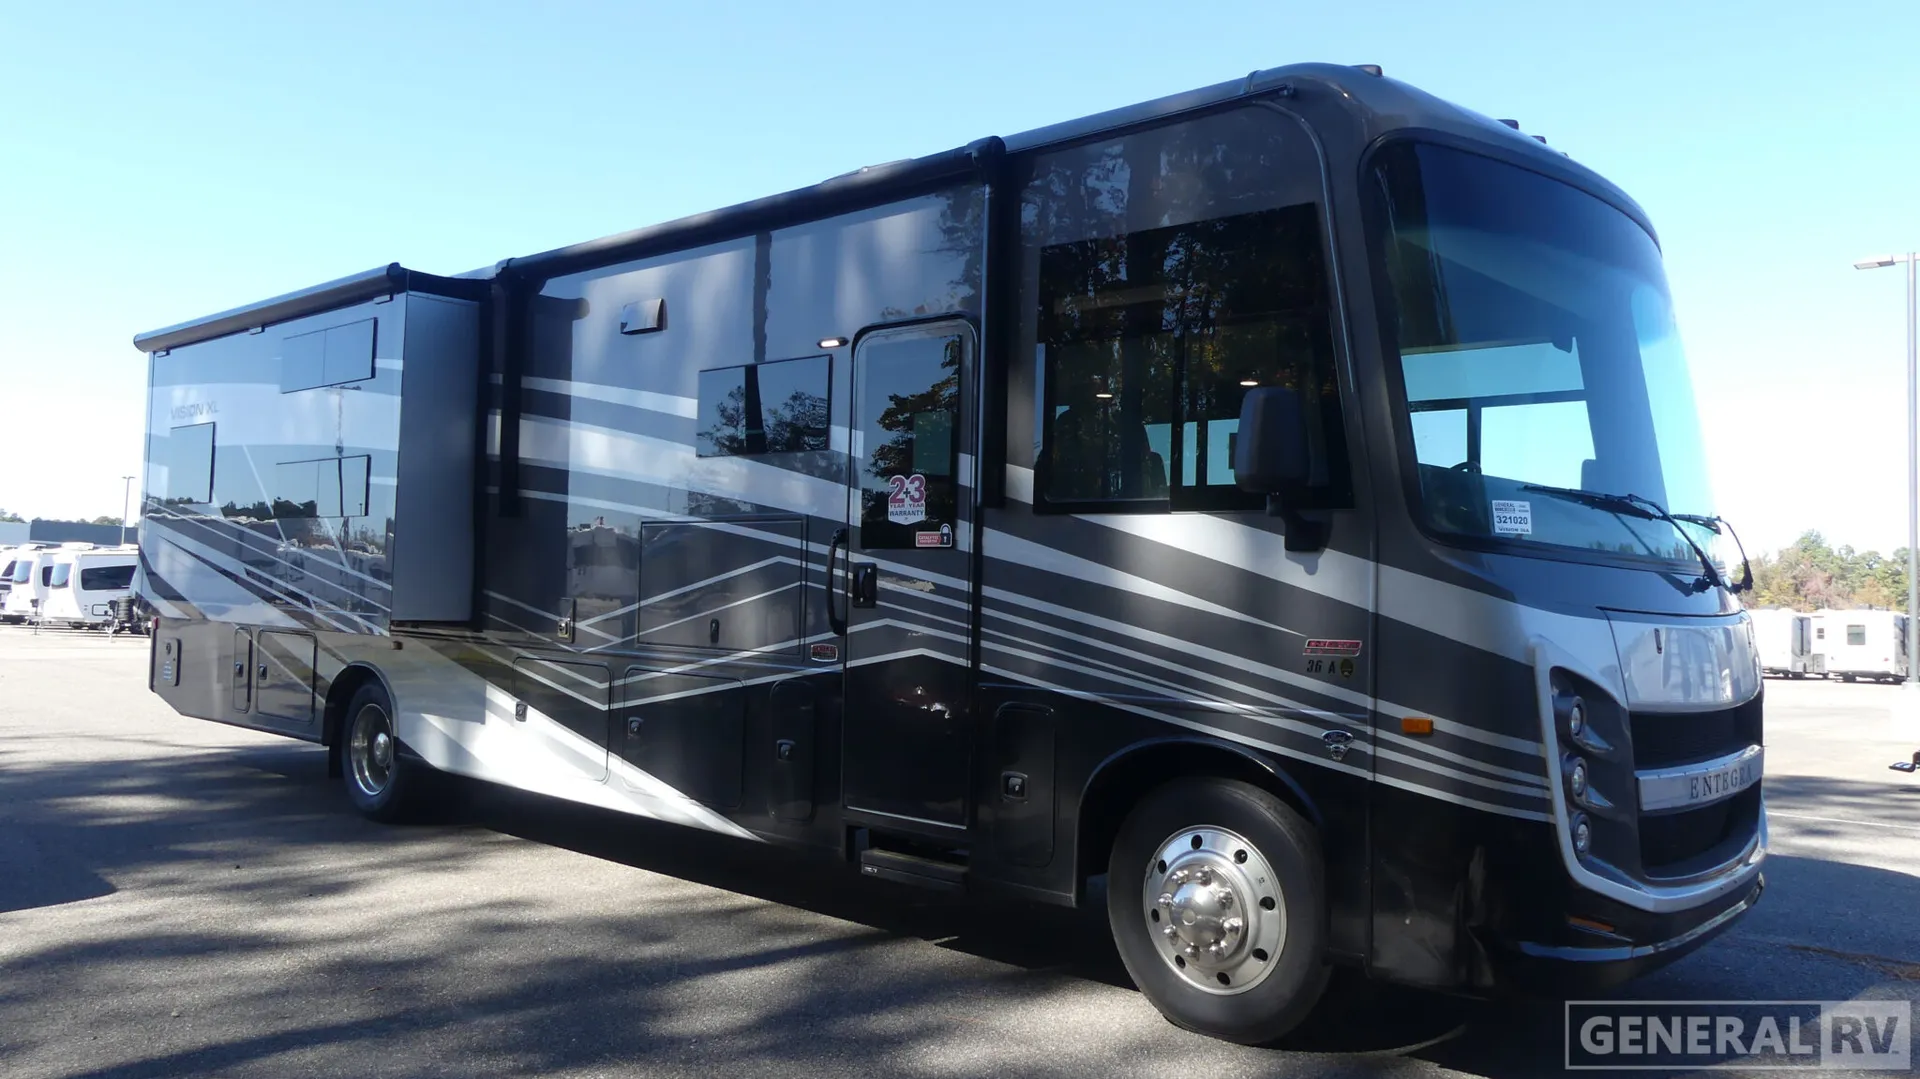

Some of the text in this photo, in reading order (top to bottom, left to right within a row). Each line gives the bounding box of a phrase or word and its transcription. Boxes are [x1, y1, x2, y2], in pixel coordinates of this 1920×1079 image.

[171, 400, 220, 420] VISION XL
[1496, 515, 1528, 525] 321020
[1306, 659, 1336, 674] 36 A
[1690, 763, 1753, 800] ENTEGRA
